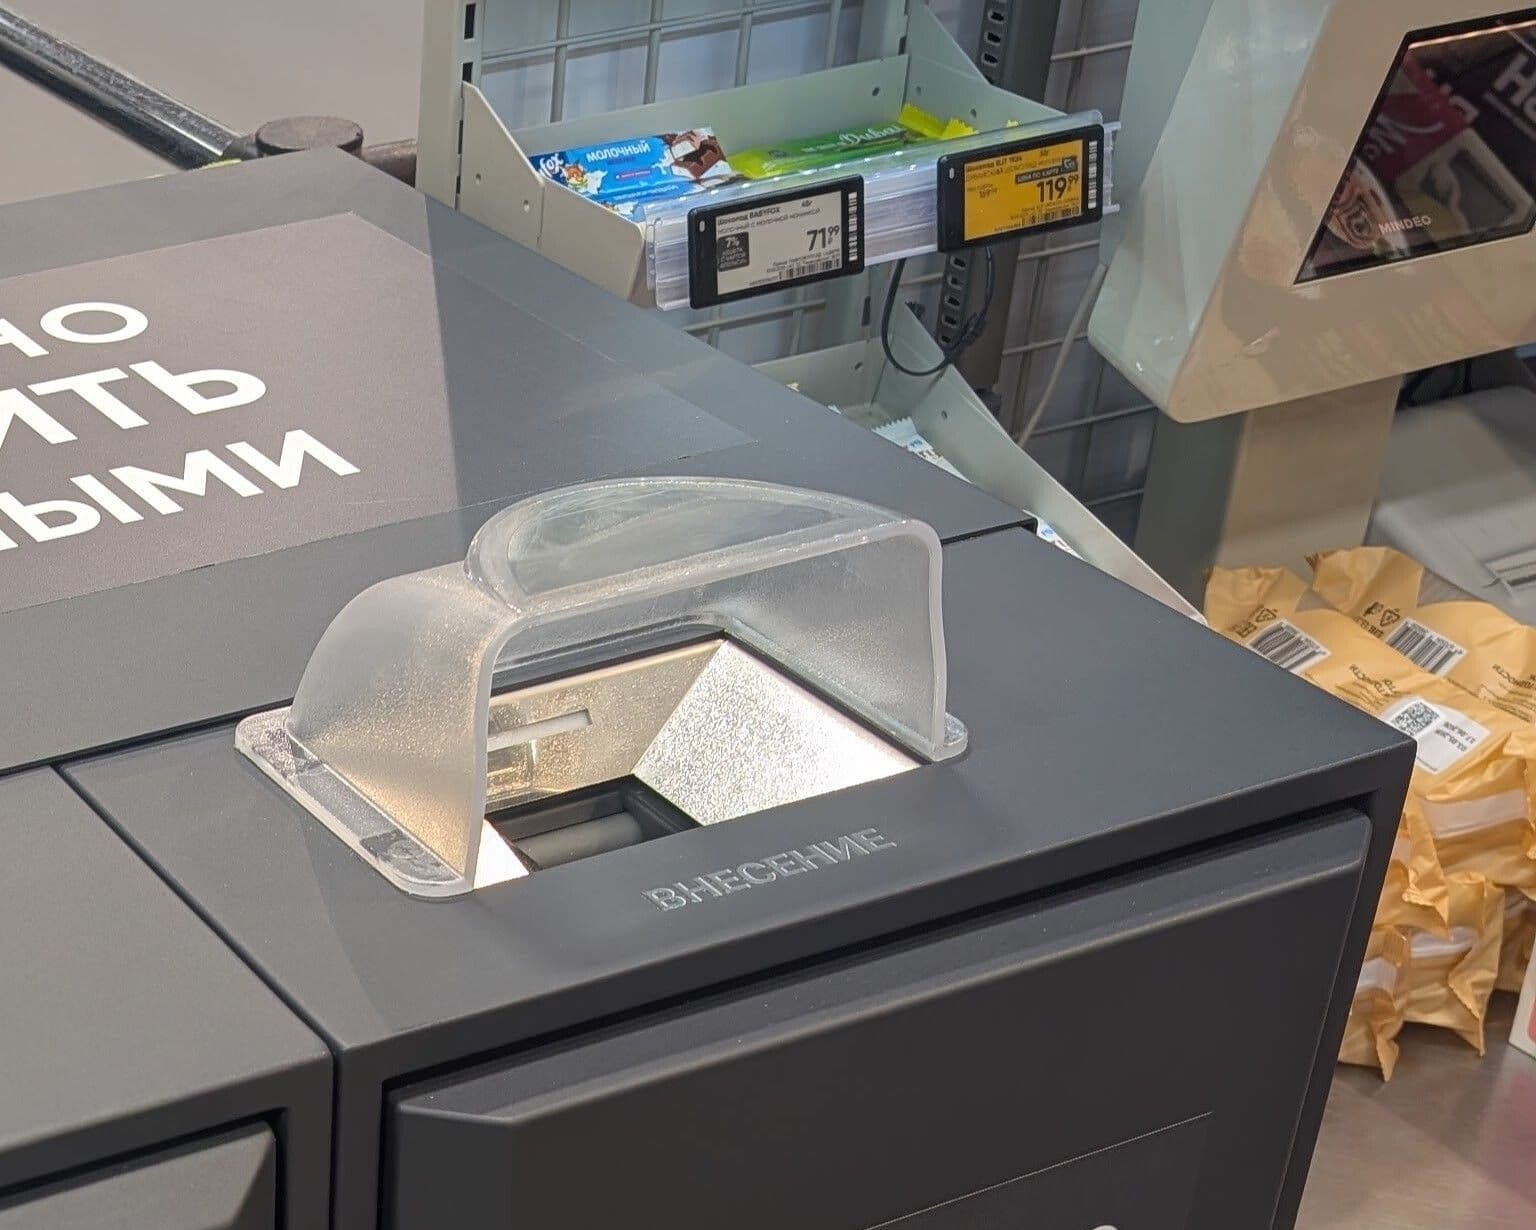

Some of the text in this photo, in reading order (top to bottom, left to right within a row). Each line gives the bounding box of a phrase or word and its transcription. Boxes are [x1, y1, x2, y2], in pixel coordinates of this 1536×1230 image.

[585, 140, 652, 163] МОЛОЧНЫЙ
[1378, 215, 1432, 236] MINDEO
[641, 826, 897, 912] ВНЕСЕНИЕ
